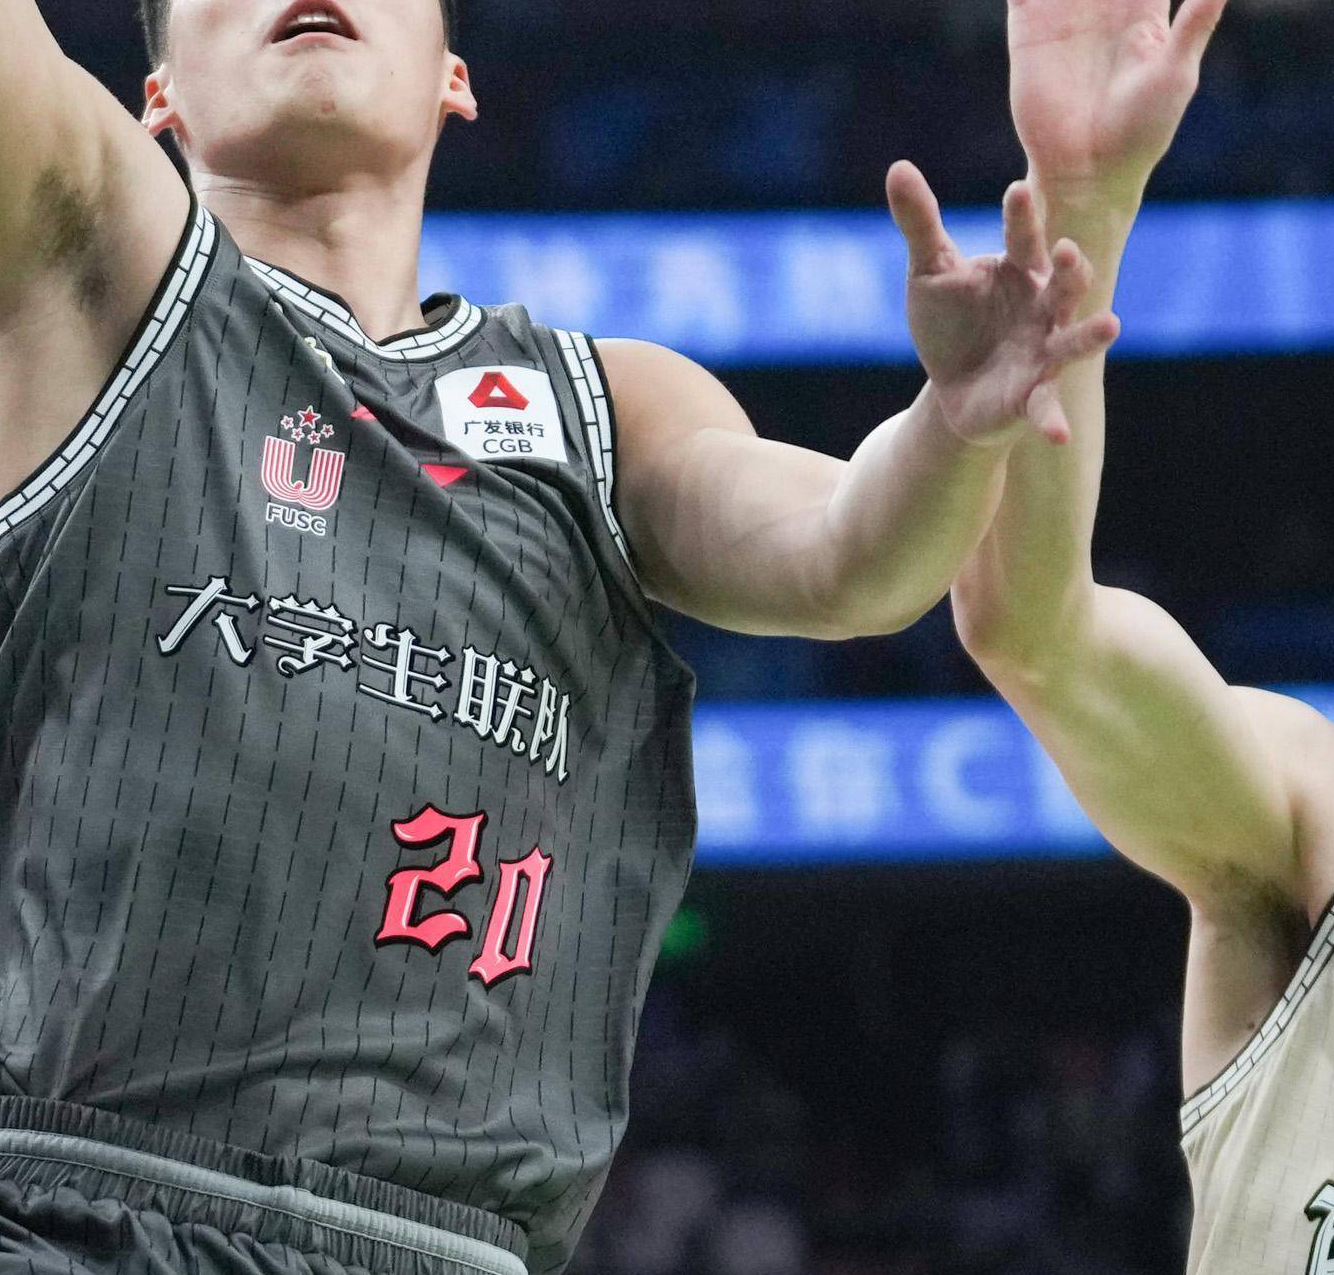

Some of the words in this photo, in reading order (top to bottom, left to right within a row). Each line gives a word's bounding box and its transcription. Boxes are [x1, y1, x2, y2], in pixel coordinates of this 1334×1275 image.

[464, 420, 545, 437] 广发银行
[483, 438, 533, 454] CGB
[266, 502, 327, 536] FUSC
[156, 575, 571, 784] 大学生联队
[374, 802, 554, 990] 20
